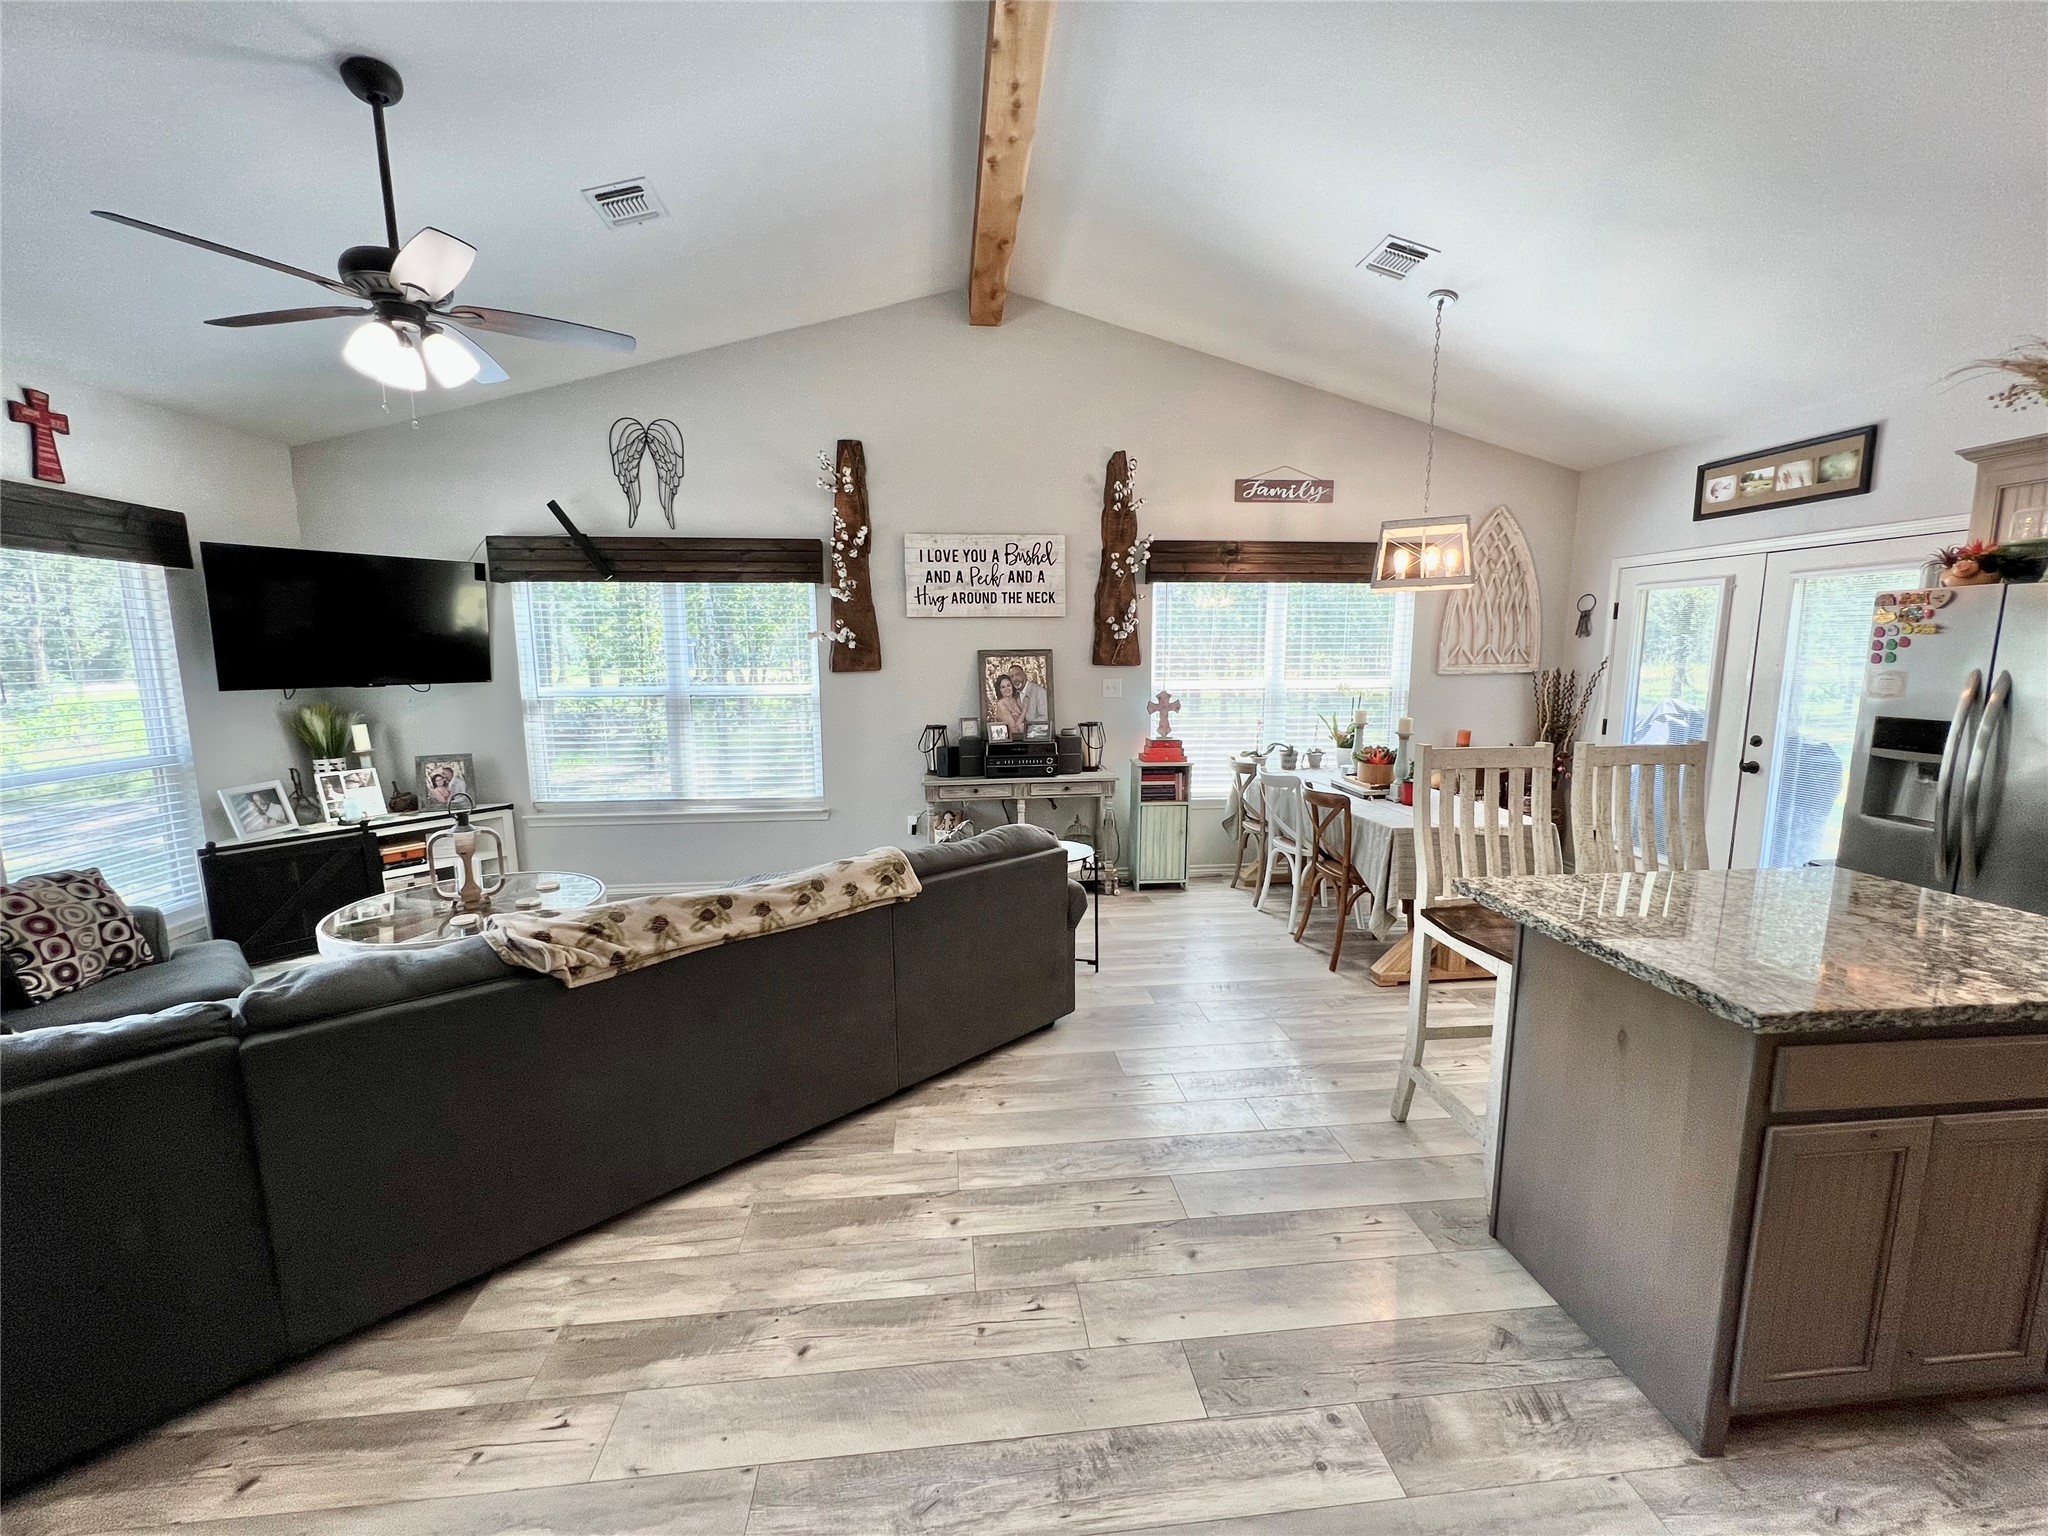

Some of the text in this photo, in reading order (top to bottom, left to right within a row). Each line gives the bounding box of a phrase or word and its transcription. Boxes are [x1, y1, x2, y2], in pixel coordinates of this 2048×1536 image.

[1242, 480, 1330, 502] Family
[919, 540, 1057, 566] I LOVE YOU A Bushel
[925, 563, 1045, 587] AND A Peck AND A
[914, 585, 1056, 612] Hug AROUND THE NECK
